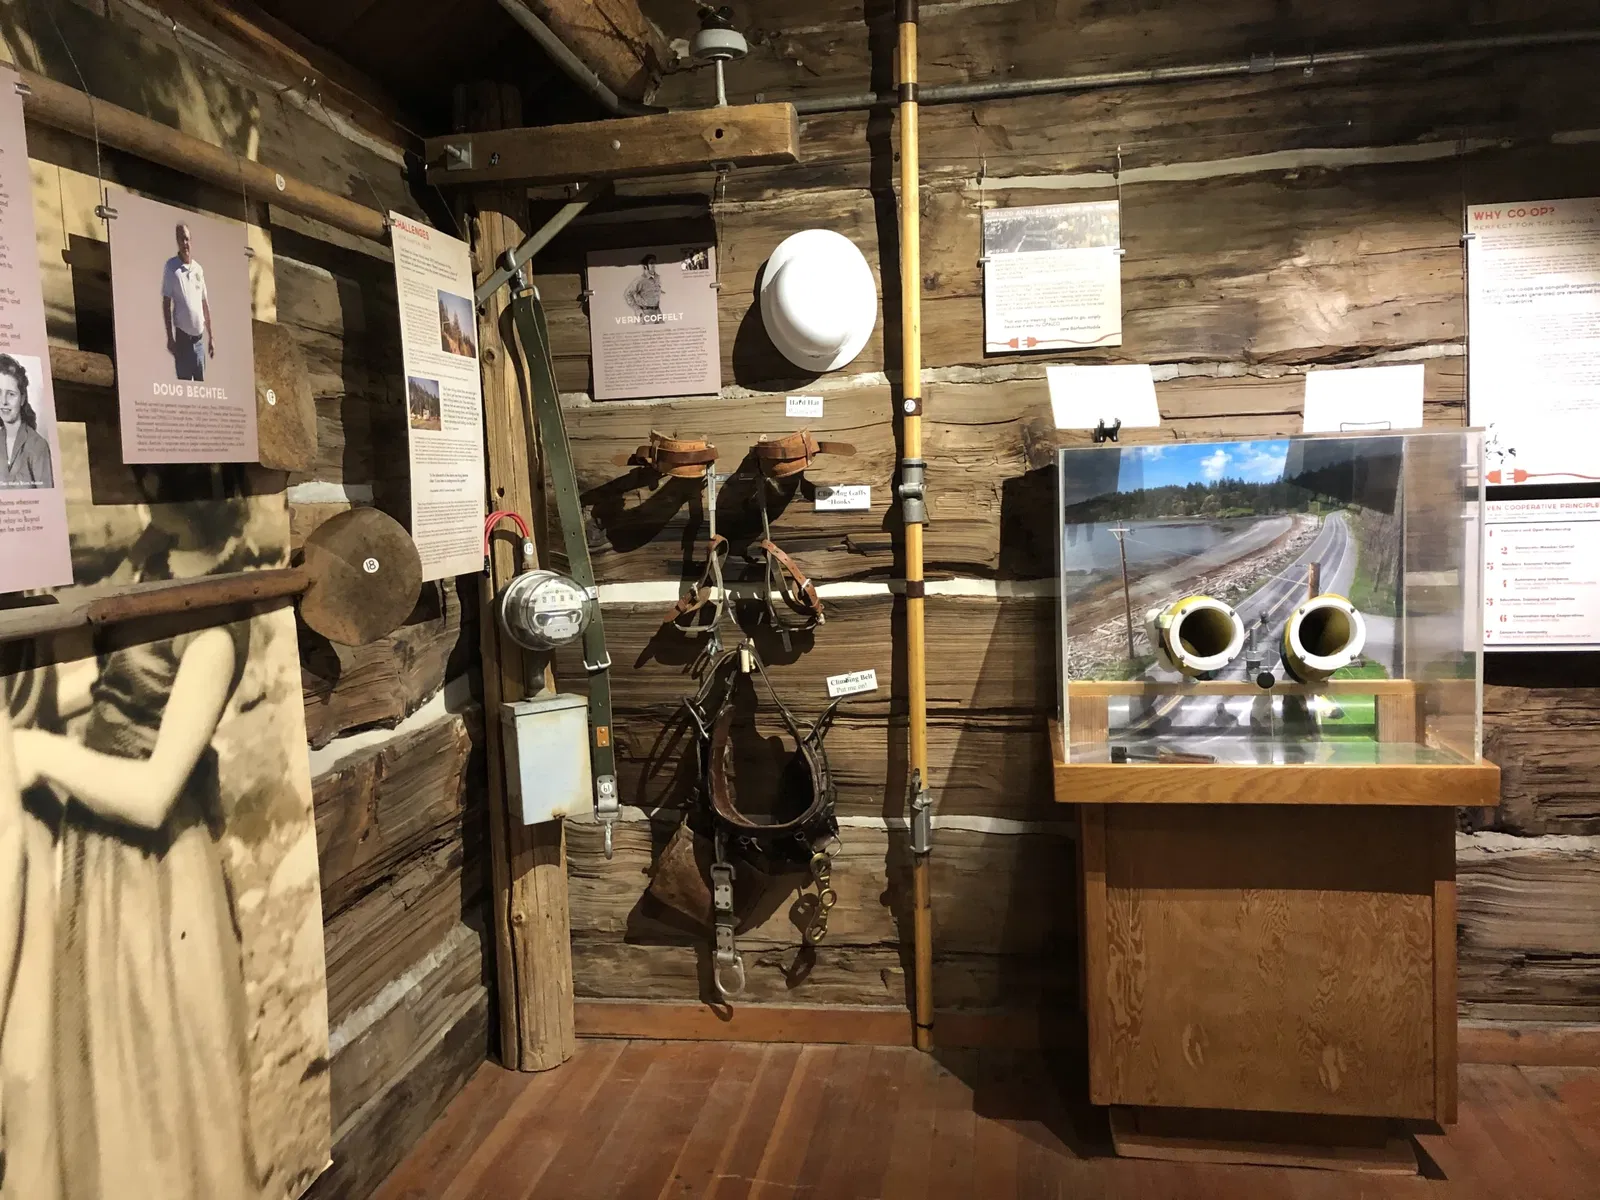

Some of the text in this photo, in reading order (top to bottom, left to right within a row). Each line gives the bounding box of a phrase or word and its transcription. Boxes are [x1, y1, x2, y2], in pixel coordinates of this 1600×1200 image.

[1474, 210, 1502, 220] WHY
[615, 312, 684, 324] VERN COFFELT
[153, 382, 228, 400] DOUG BECHTEL
[1504, 502, 1557, 511] COOPERATIVE
[365, 560, 377, 571] 18
[830, 676, 860, 686] Climbing
